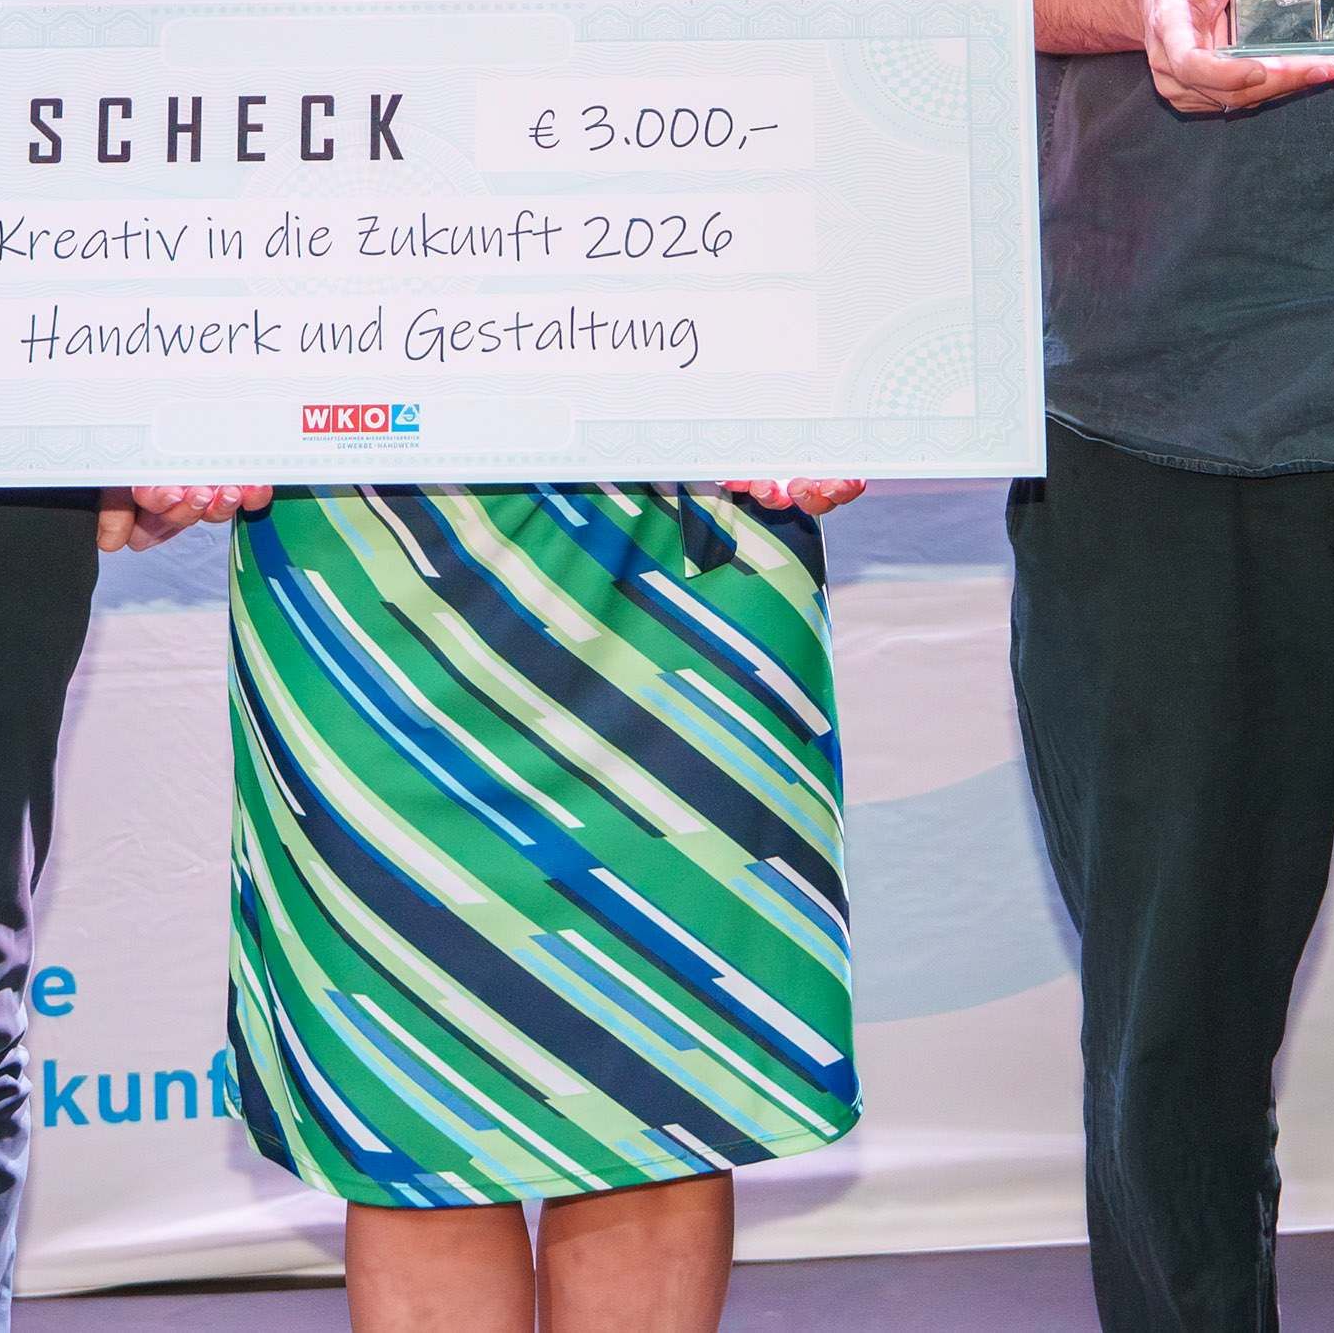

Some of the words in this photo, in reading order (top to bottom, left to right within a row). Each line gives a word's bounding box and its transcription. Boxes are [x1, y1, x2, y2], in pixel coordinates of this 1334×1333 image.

[29, 93, 404, 164] SCHECK
[528, 109, 560, 150] €
[208, 216, 243, 260] in
[264, 212, 333, 258] die
[357, 212, 562, 262] Zukunft
[583, 211, 733, 259] 2026
[21, 305, 282, 363] Handwerk
[300, 306, 382, 356] und
[405, 306, 699, 369] Gestaltung
[304, 407, 386, 429] WKO
